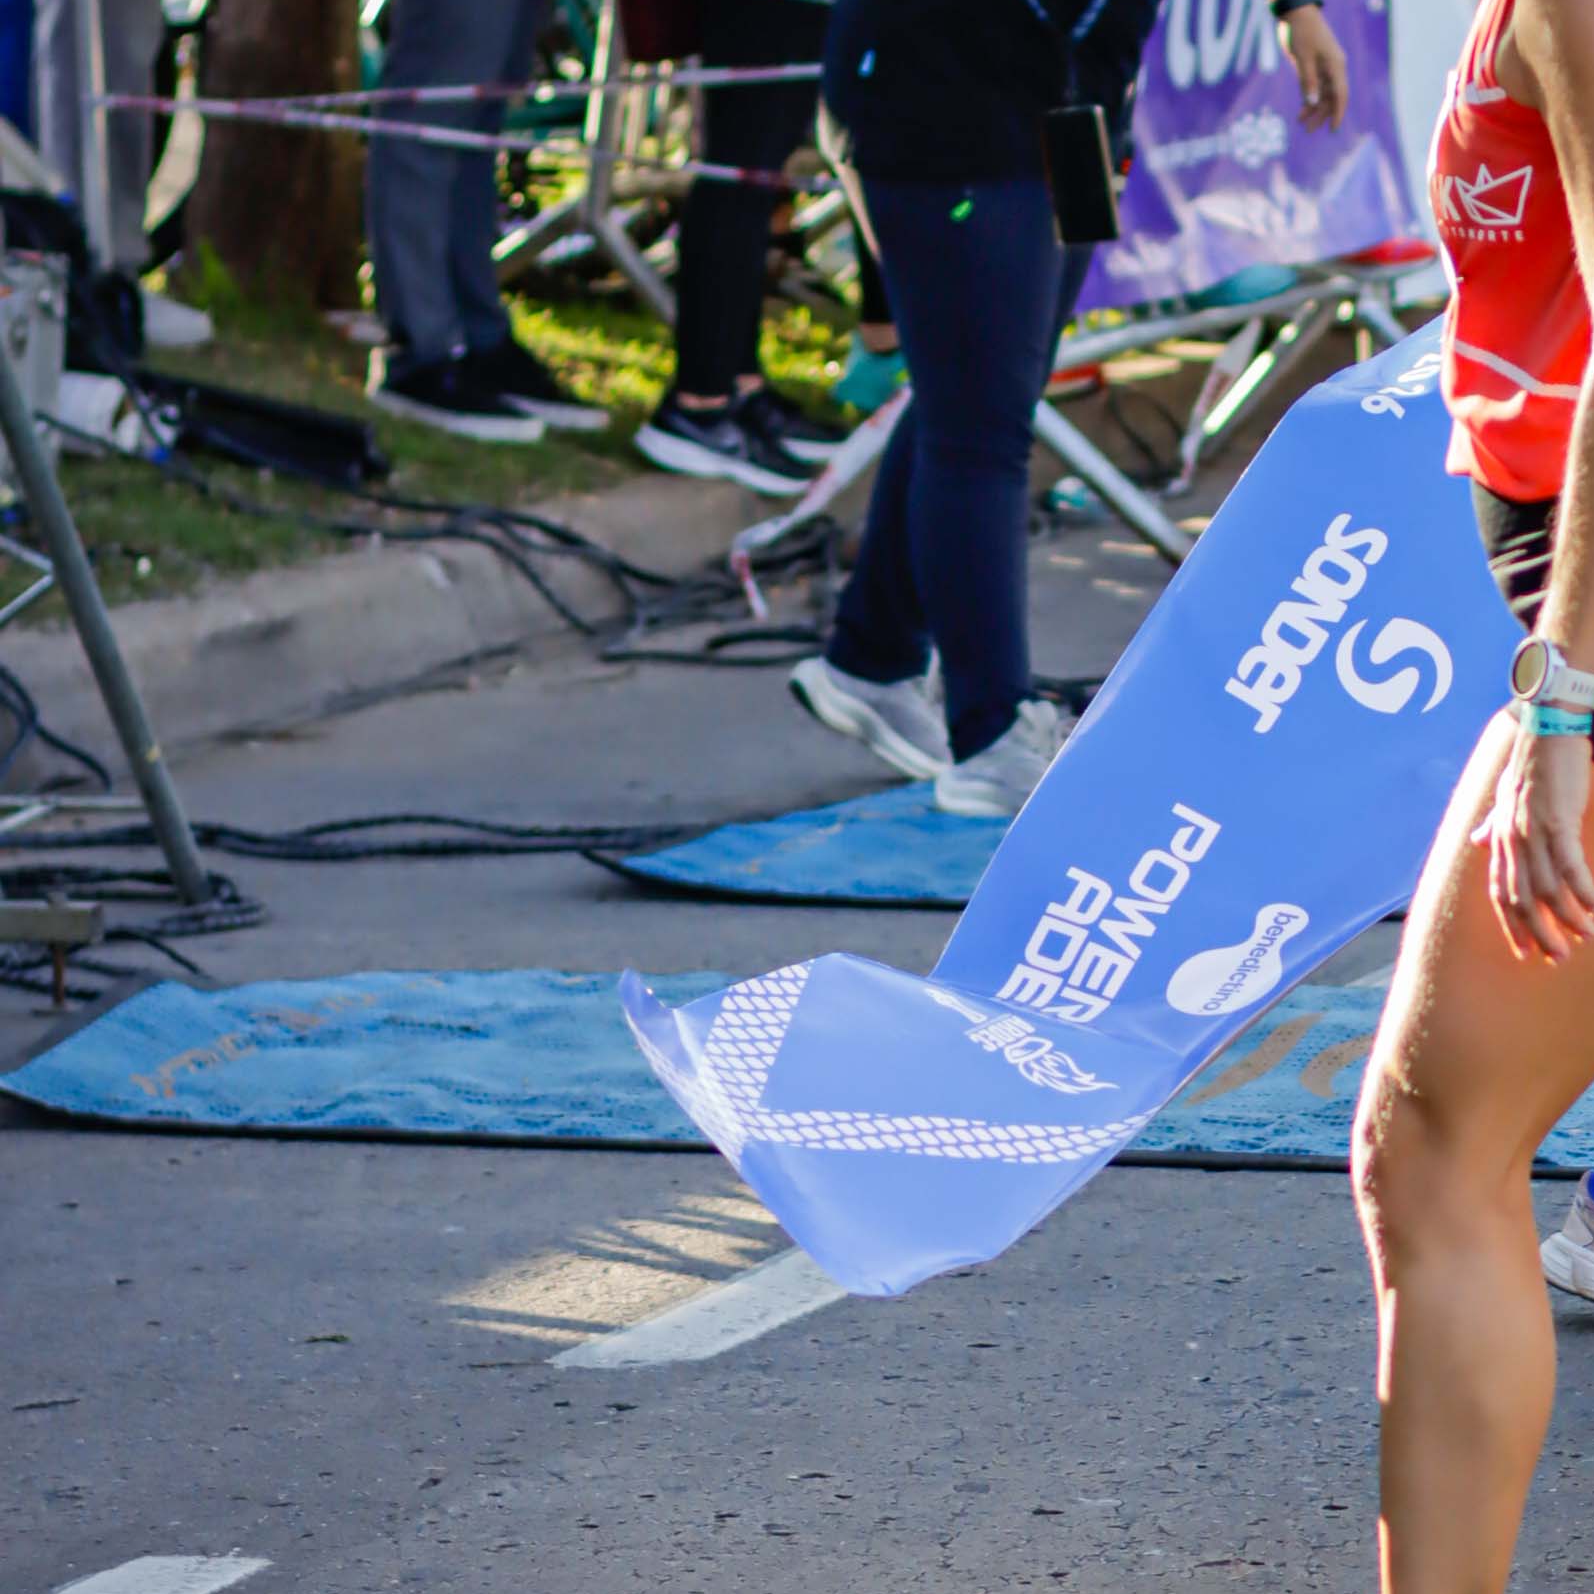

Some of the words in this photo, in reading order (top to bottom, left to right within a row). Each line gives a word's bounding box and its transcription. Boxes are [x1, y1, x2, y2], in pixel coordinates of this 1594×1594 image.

[994, 865, 1113, 1013] ADE
[1040, 802, 1223, 1024] POWER
[1200, 911, 1300, 1013] benedictino
